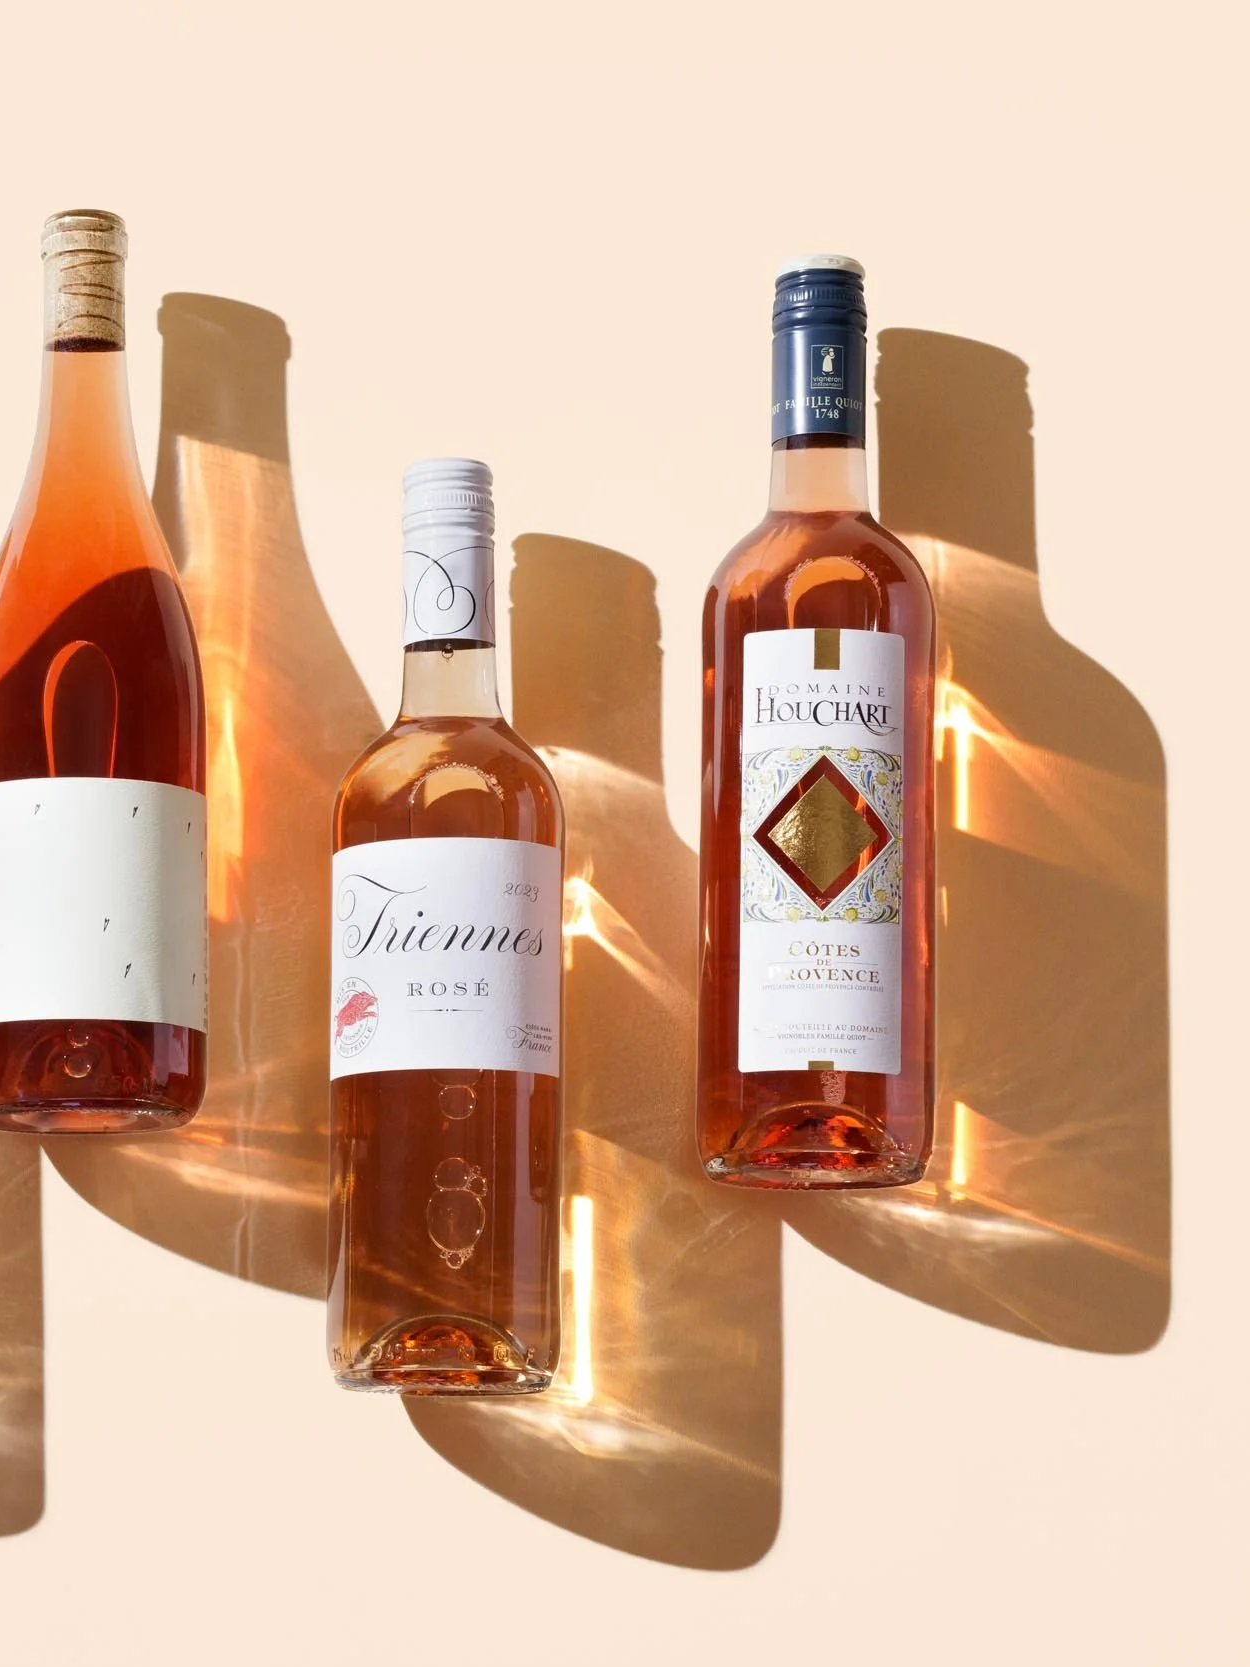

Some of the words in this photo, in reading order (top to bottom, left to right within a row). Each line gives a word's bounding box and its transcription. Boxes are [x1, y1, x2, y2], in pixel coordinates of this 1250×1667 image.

[785, 396, 831, 409] FAILLE
[835, 396, 863, 412] QUIOT
[815, 408, 839, 419] 1748
[768, 683, 886, 698] DOMAINE
[502, 882, 540, 903] 2023
[336, 874, 544, 959] Triennes
[789, 940, 861, 958] CÔTES
[816, 958, 832, 967] DE
[406, 978, 490, 997] ROSÉ
[784, 1023, 832, 1031] OUTEILLE
[850, 1024, 888, 1034] DOMAINE
[506, 1025, 552, 1054] France
[778, 1032, 815, 1040] VIGNOBLES
[816, 1032, 846, 1040] FAMILLE
[846, 1033, 867, 1041] QUIOT
[830, 1047, 858, 1055] FRANCE
